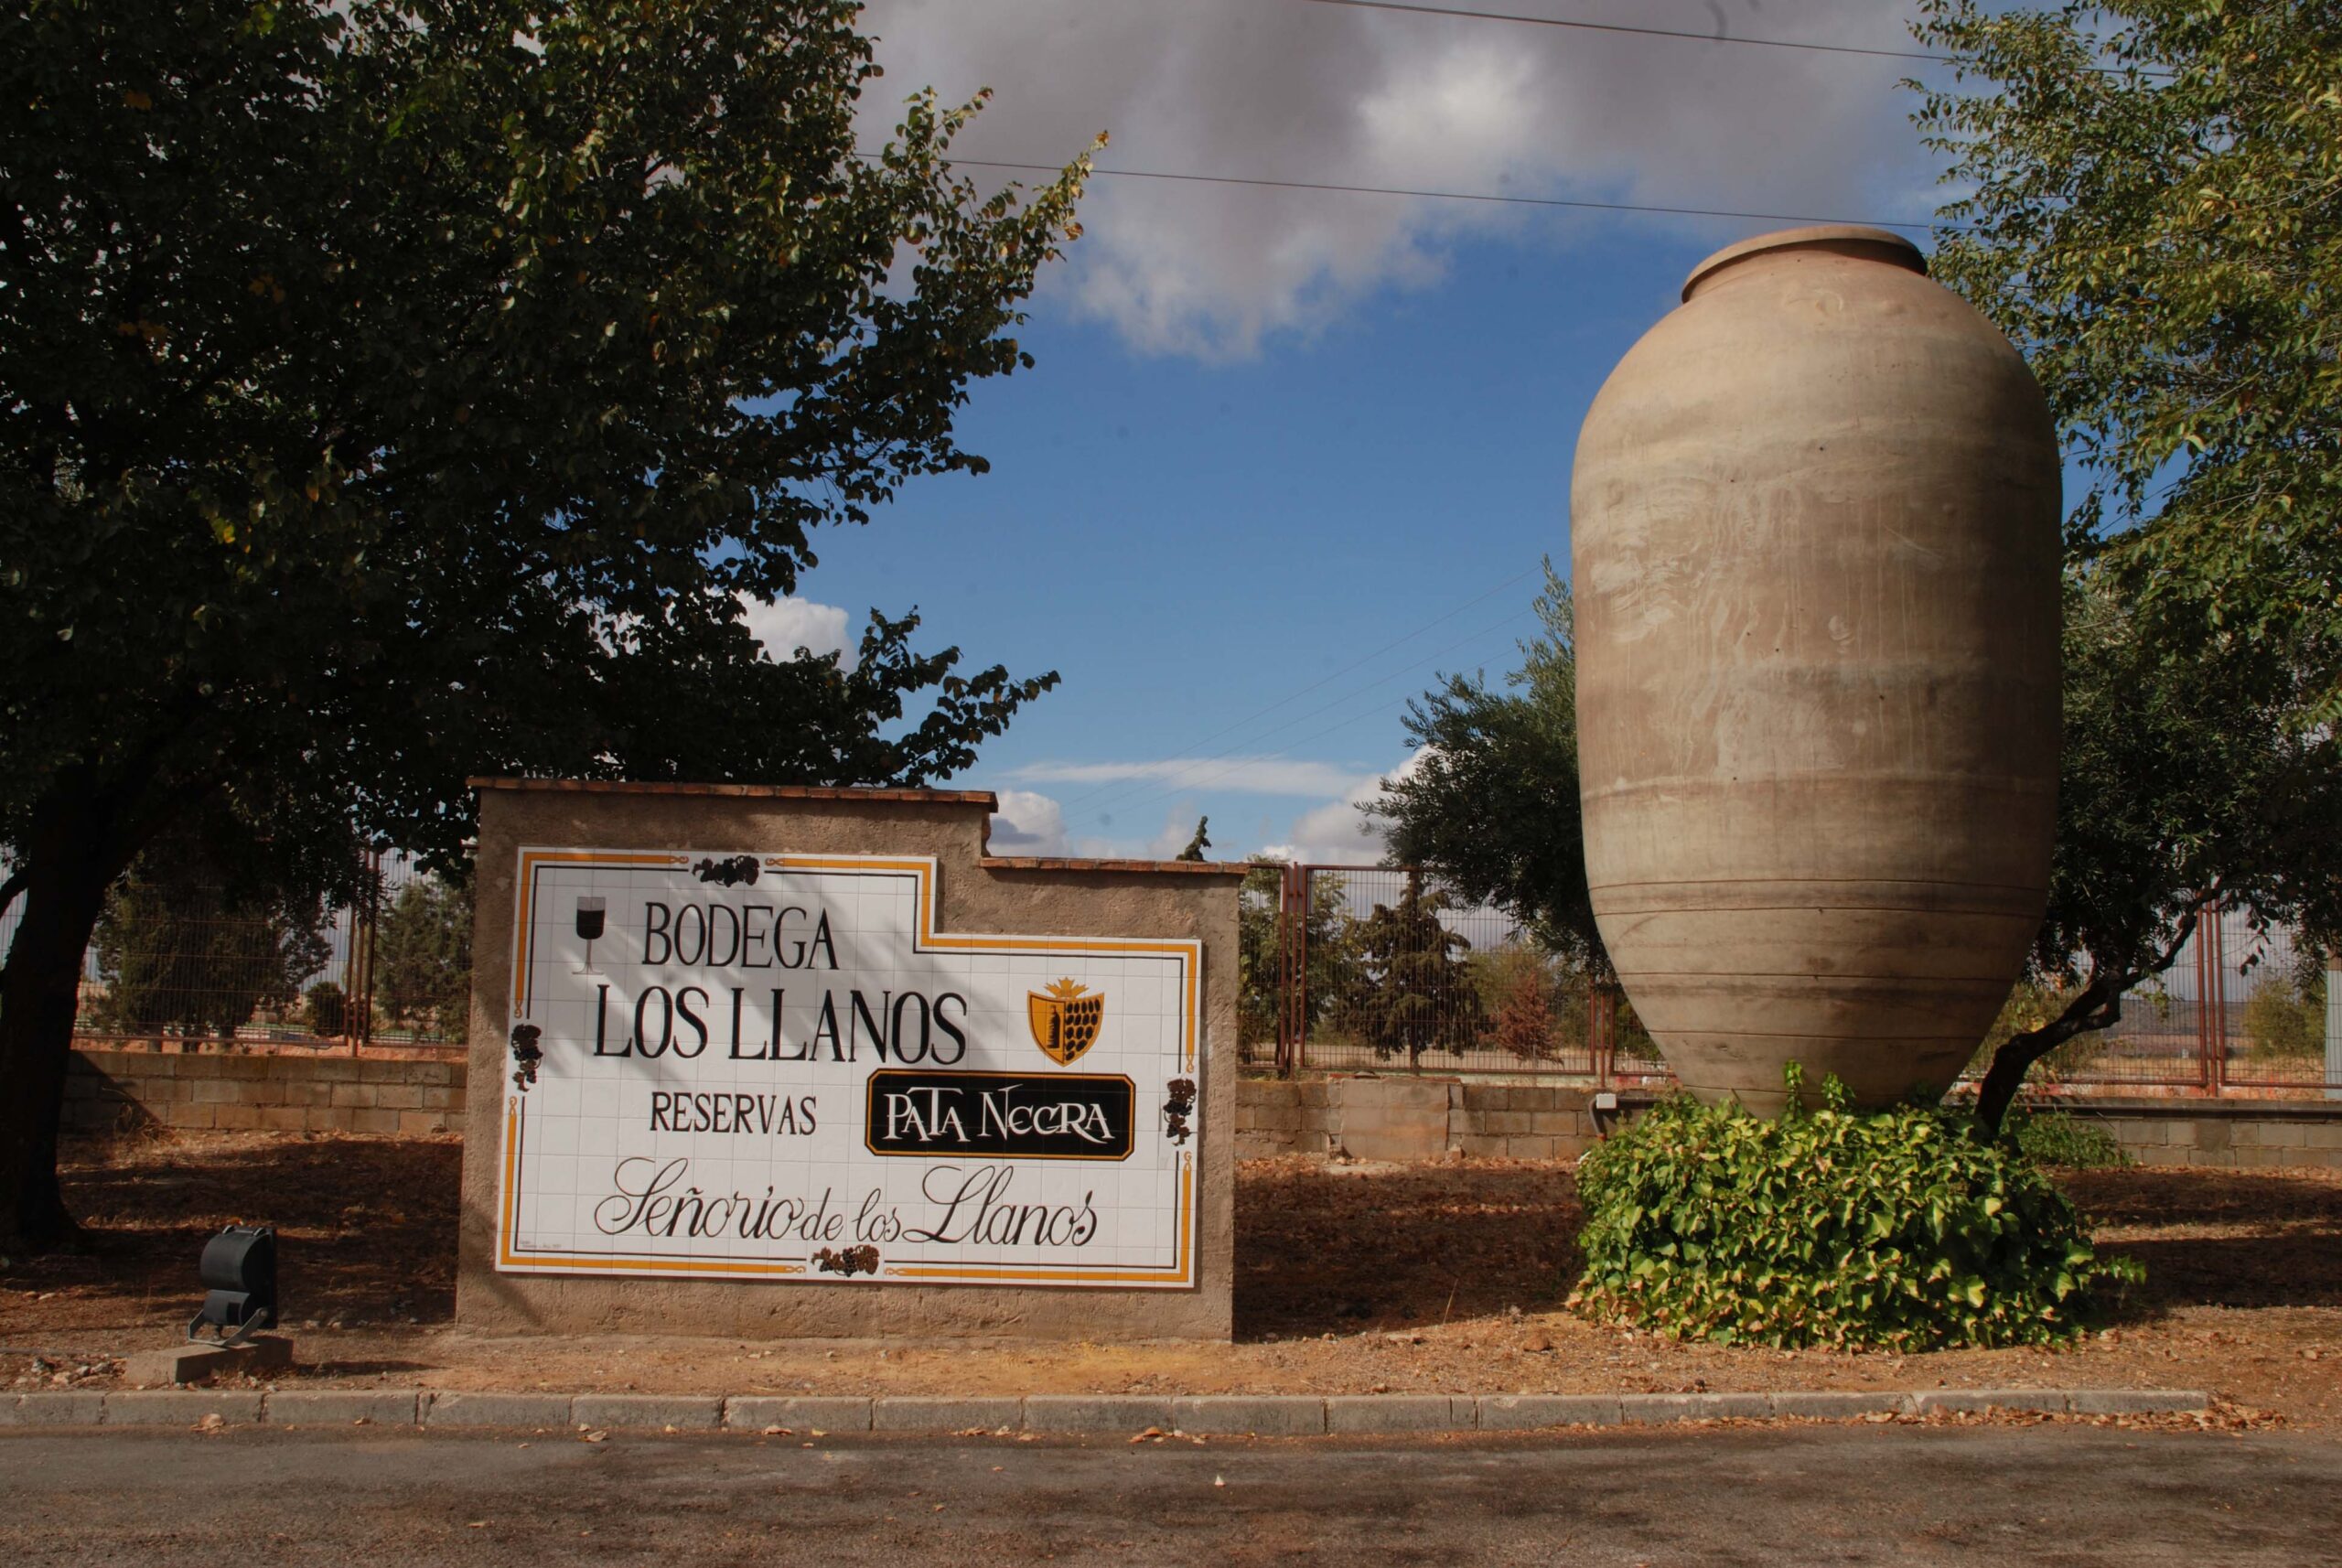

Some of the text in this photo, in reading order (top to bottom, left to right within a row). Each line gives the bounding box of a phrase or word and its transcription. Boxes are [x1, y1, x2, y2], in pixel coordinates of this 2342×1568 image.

[641, 901, 839, 971] BODEGA
[594, 983, 967, 1065] LOS LLANOS
[650, 1090, 817, 1136] RESERVAS
[882, 1083, 1115, 1144] PATA NEGRA
[799, 1187, 844, 1241] de
[851, 1187, 902, 1242] los
[902, 1165, 1099, 1246] Llanos
